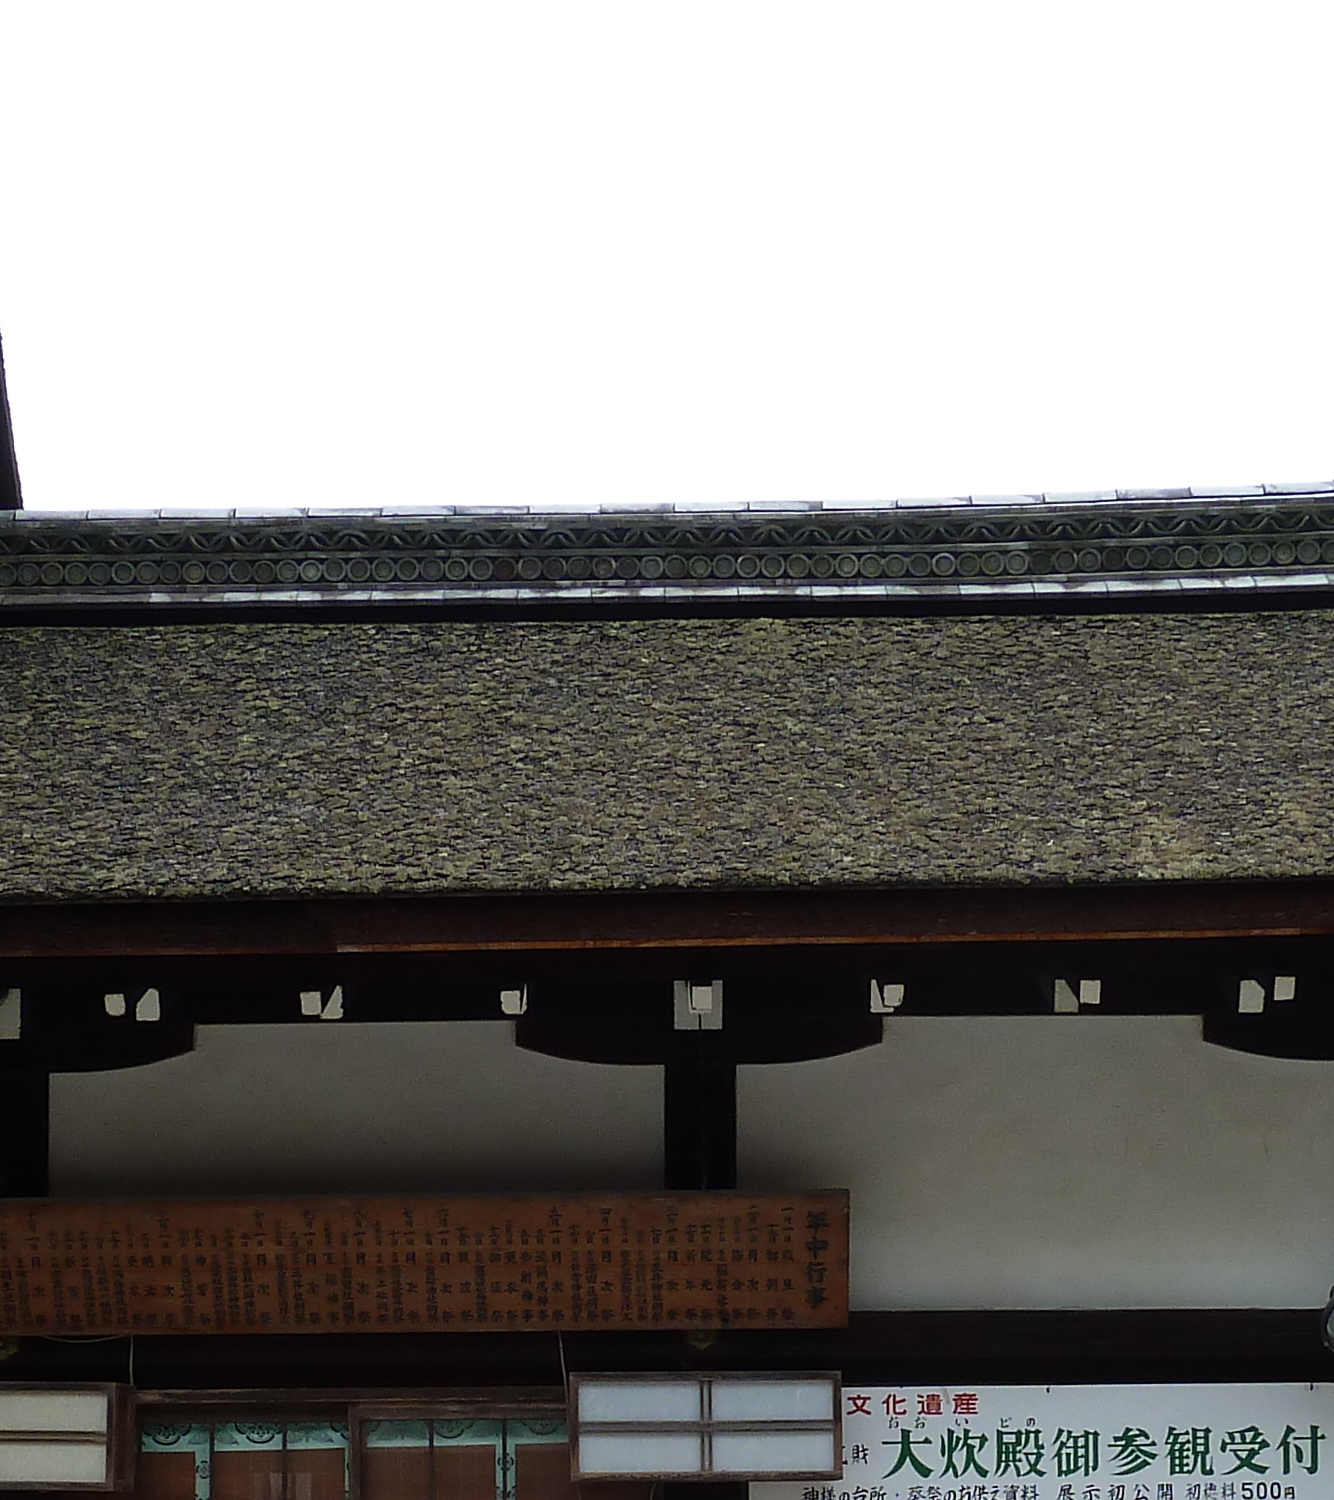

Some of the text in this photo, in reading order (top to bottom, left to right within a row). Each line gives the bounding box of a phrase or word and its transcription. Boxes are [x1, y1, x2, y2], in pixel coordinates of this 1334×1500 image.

[805, 1211, 829, 1310] 年中行事
[846, 1393, 979, 1416] 文化遺産
[881, 1423, 1327, 1480] 大炊殿御参観受付
